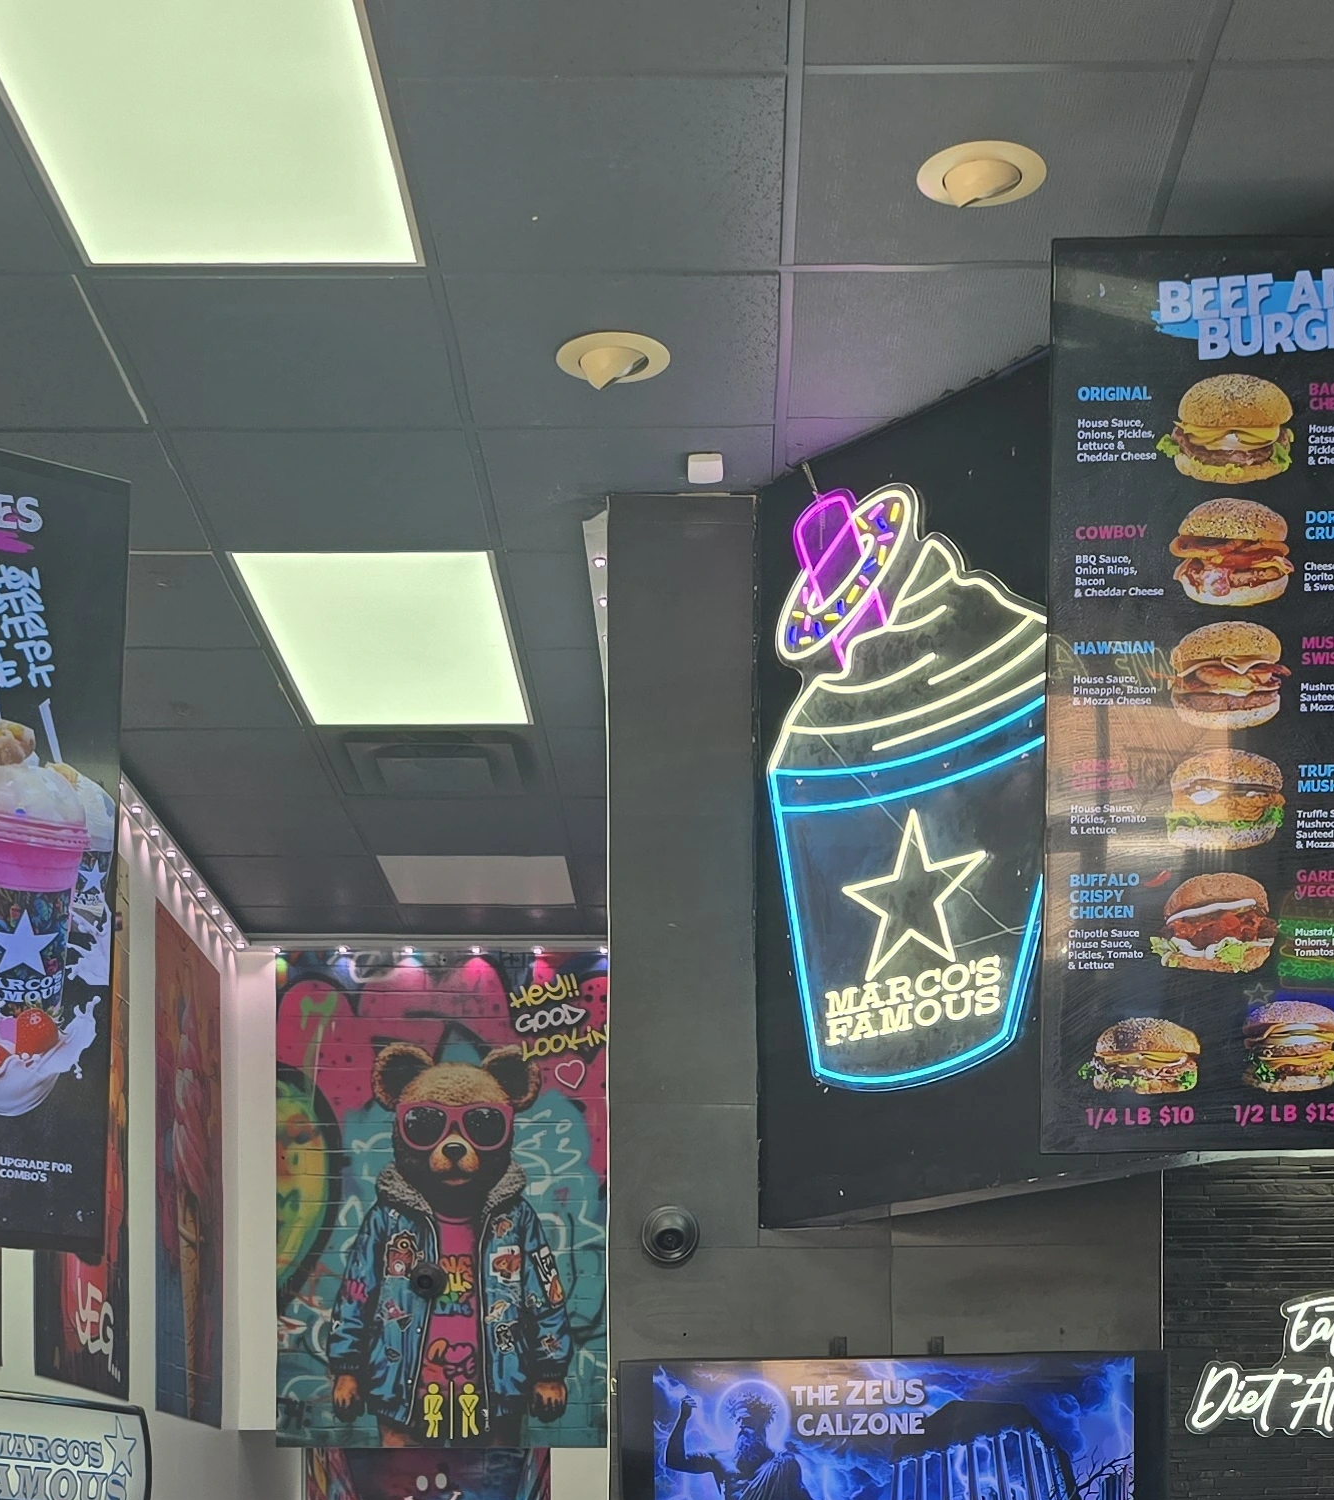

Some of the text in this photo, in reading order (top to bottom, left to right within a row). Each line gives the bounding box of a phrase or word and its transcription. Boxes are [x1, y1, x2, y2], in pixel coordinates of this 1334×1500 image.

[1158, 272, 1273, 323] BEEF
[1077, 386, 1152, 401] ORIGINAL
[1077, 417, 1144, 429] House Sauce,
[1077, 429, 1155, 441] Onions, Pickles,
[1075, 524, 1147, 540] COWBOY
[825, 955, 1002, 1018] MARCO'S
[515, 1003, 586, 1032] GOOD
[825, 982, 1002, 1046] FAMOUS
[1086, 1105, 1194, 1129] 1/4 LB $10
[0, 1156, 73, 1174] UPGRADE FOR
[0, 1168, 48, 1183] COMBO'S
[791, 1379, 925, 1406] THE ZEUS
[1196, 1367, 1303, 1432] Diet
[796, 1412, 925, 1435] CALZONE
